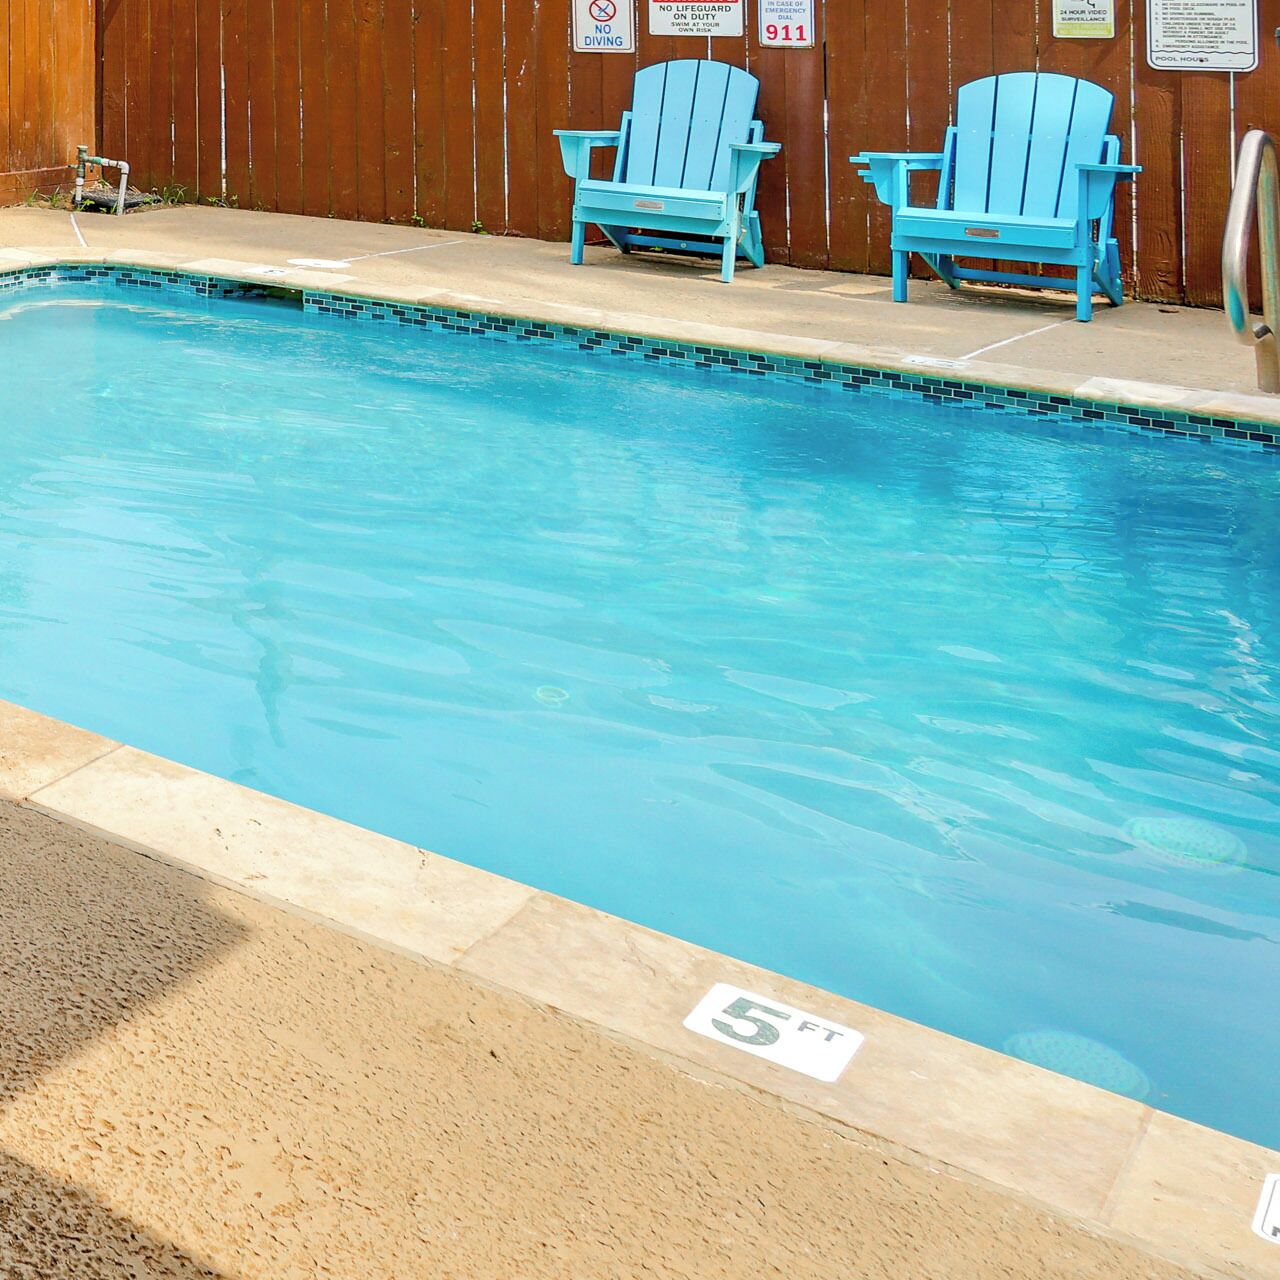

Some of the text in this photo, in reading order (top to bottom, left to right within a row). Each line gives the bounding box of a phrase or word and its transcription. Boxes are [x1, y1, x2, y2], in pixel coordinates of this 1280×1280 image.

[595, 24, 611, 34] NO
[766, 24, 806, 41] 911
[584, 36, 623, 46] DIVING
[711, 996, 844, 1047] 5 FT
